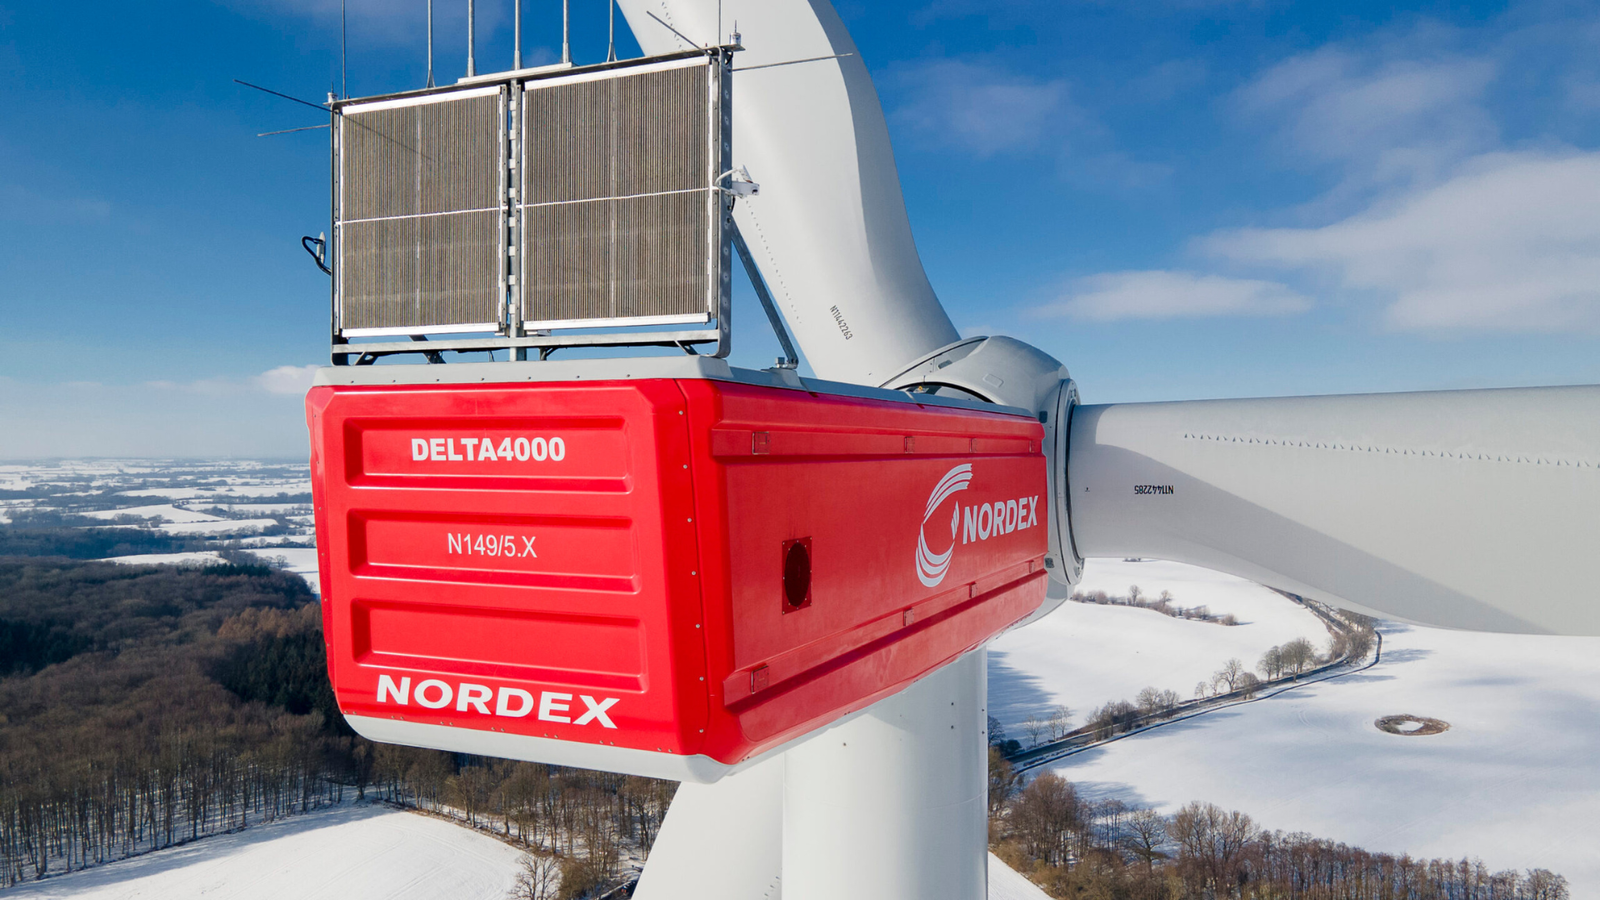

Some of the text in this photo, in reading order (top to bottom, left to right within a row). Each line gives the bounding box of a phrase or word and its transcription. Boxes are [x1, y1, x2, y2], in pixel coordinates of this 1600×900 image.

[830, 304, 853, 340] N11442263
[411, 437, 566, 461] DELTA4000
[1134, 485, 1174, 494] N11442285
[962, 495, 1039, 545] NORDEX
[447, 533, 538, 558] N149/5.X
[376, 674, 621, 729] NORDEX
